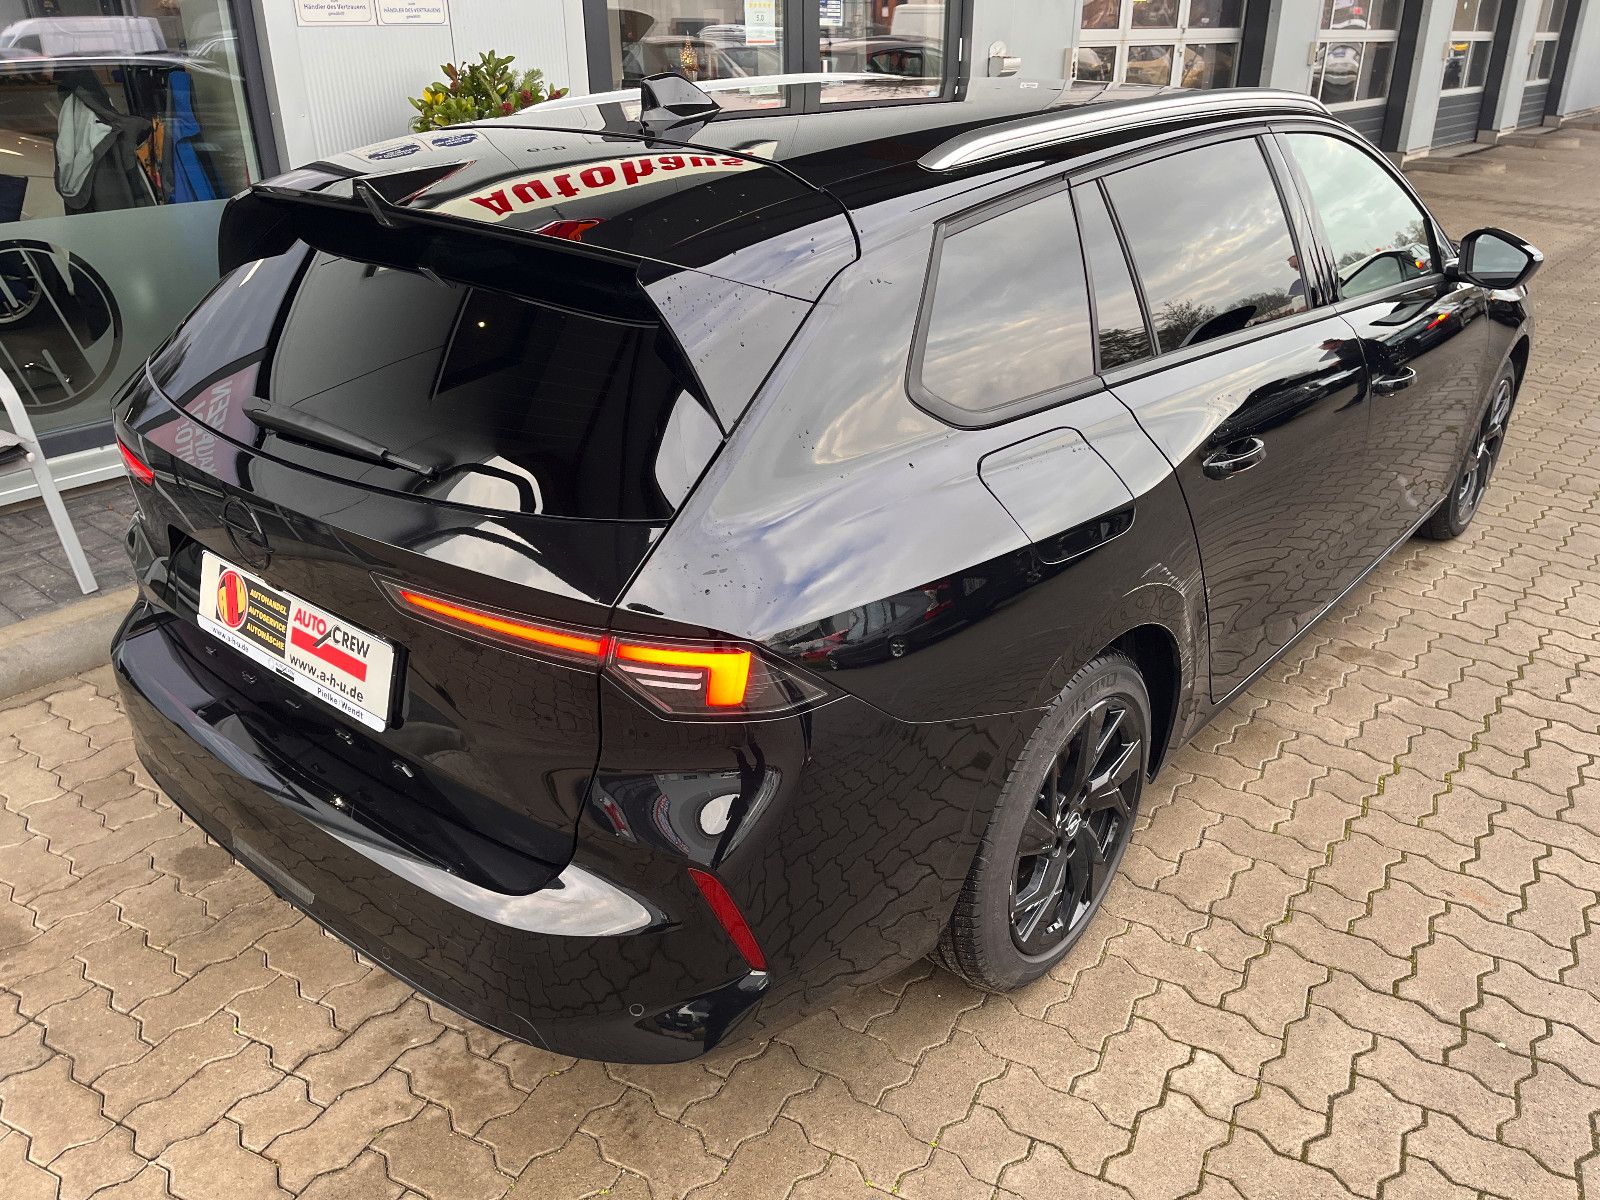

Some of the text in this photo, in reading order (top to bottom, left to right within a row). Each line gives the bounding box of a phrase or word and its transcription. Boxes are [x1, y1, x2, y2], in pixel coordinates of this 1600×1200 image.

[249, 588, 288, 616] AUTOHANDEL
[248, 605, 287, 633] AUTOSERVICE
[293, 607, 370, 658] AUTO CREW
[289, 653, 364, 703] www.a-h-u.de
[317, 687, 338, 705] Pielke
